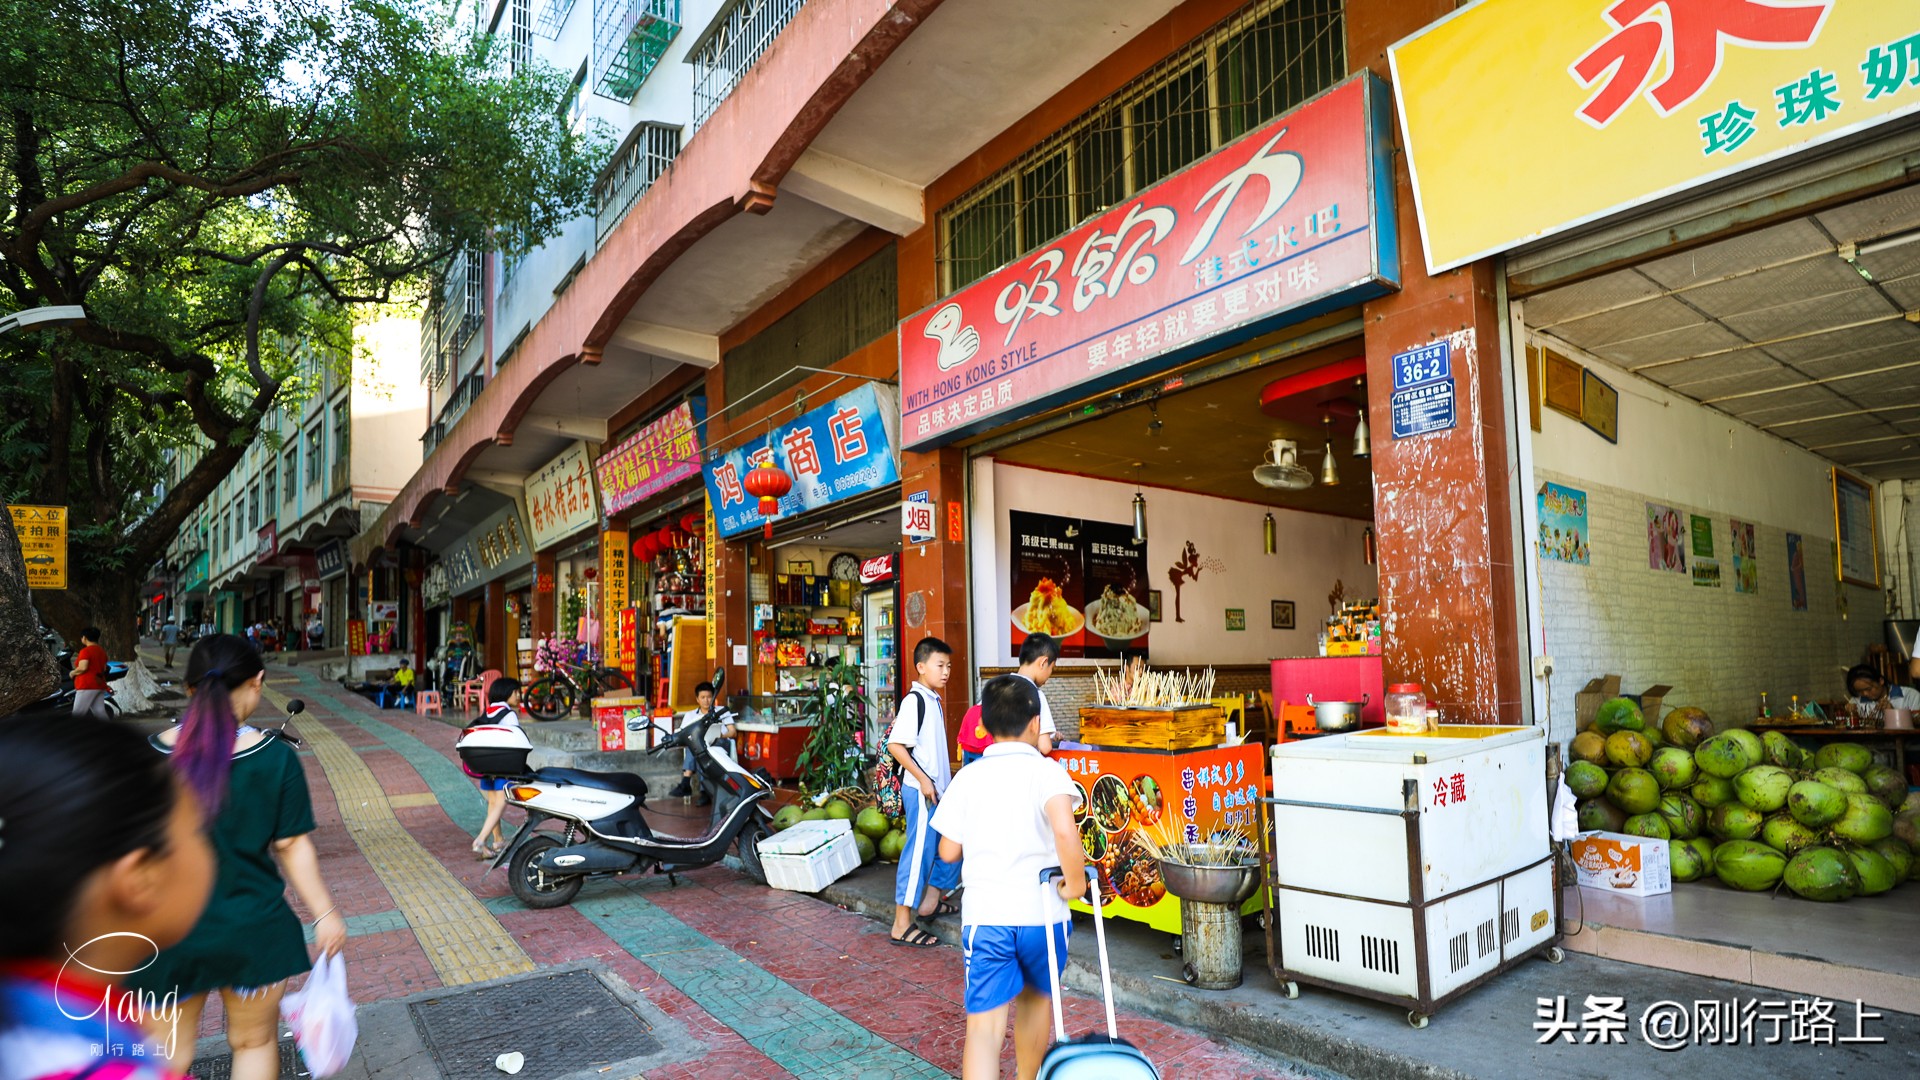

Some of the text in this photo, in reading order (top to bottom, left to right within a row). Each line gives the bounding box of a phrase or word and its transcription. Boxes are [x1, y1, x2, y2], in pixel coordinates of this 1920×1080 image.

[1698, 32, 1920, 157] 珍珠奶
[1195, 203, 1341, 290] 港式水吧
[1086, 258, 1321, 372] 要年轻就要更对味
[907, 342, 1038, 410] WITH HONG KONG STYLE
[1403, 359, 1440, 383] 36-2
[917, 379, 1014, 436] 品味决定品质
[906, 506, 930, 532] 烟
[1196, 759, 1245, 789] 样式多多
[1432, 772, 1467, 808] 冷藏
